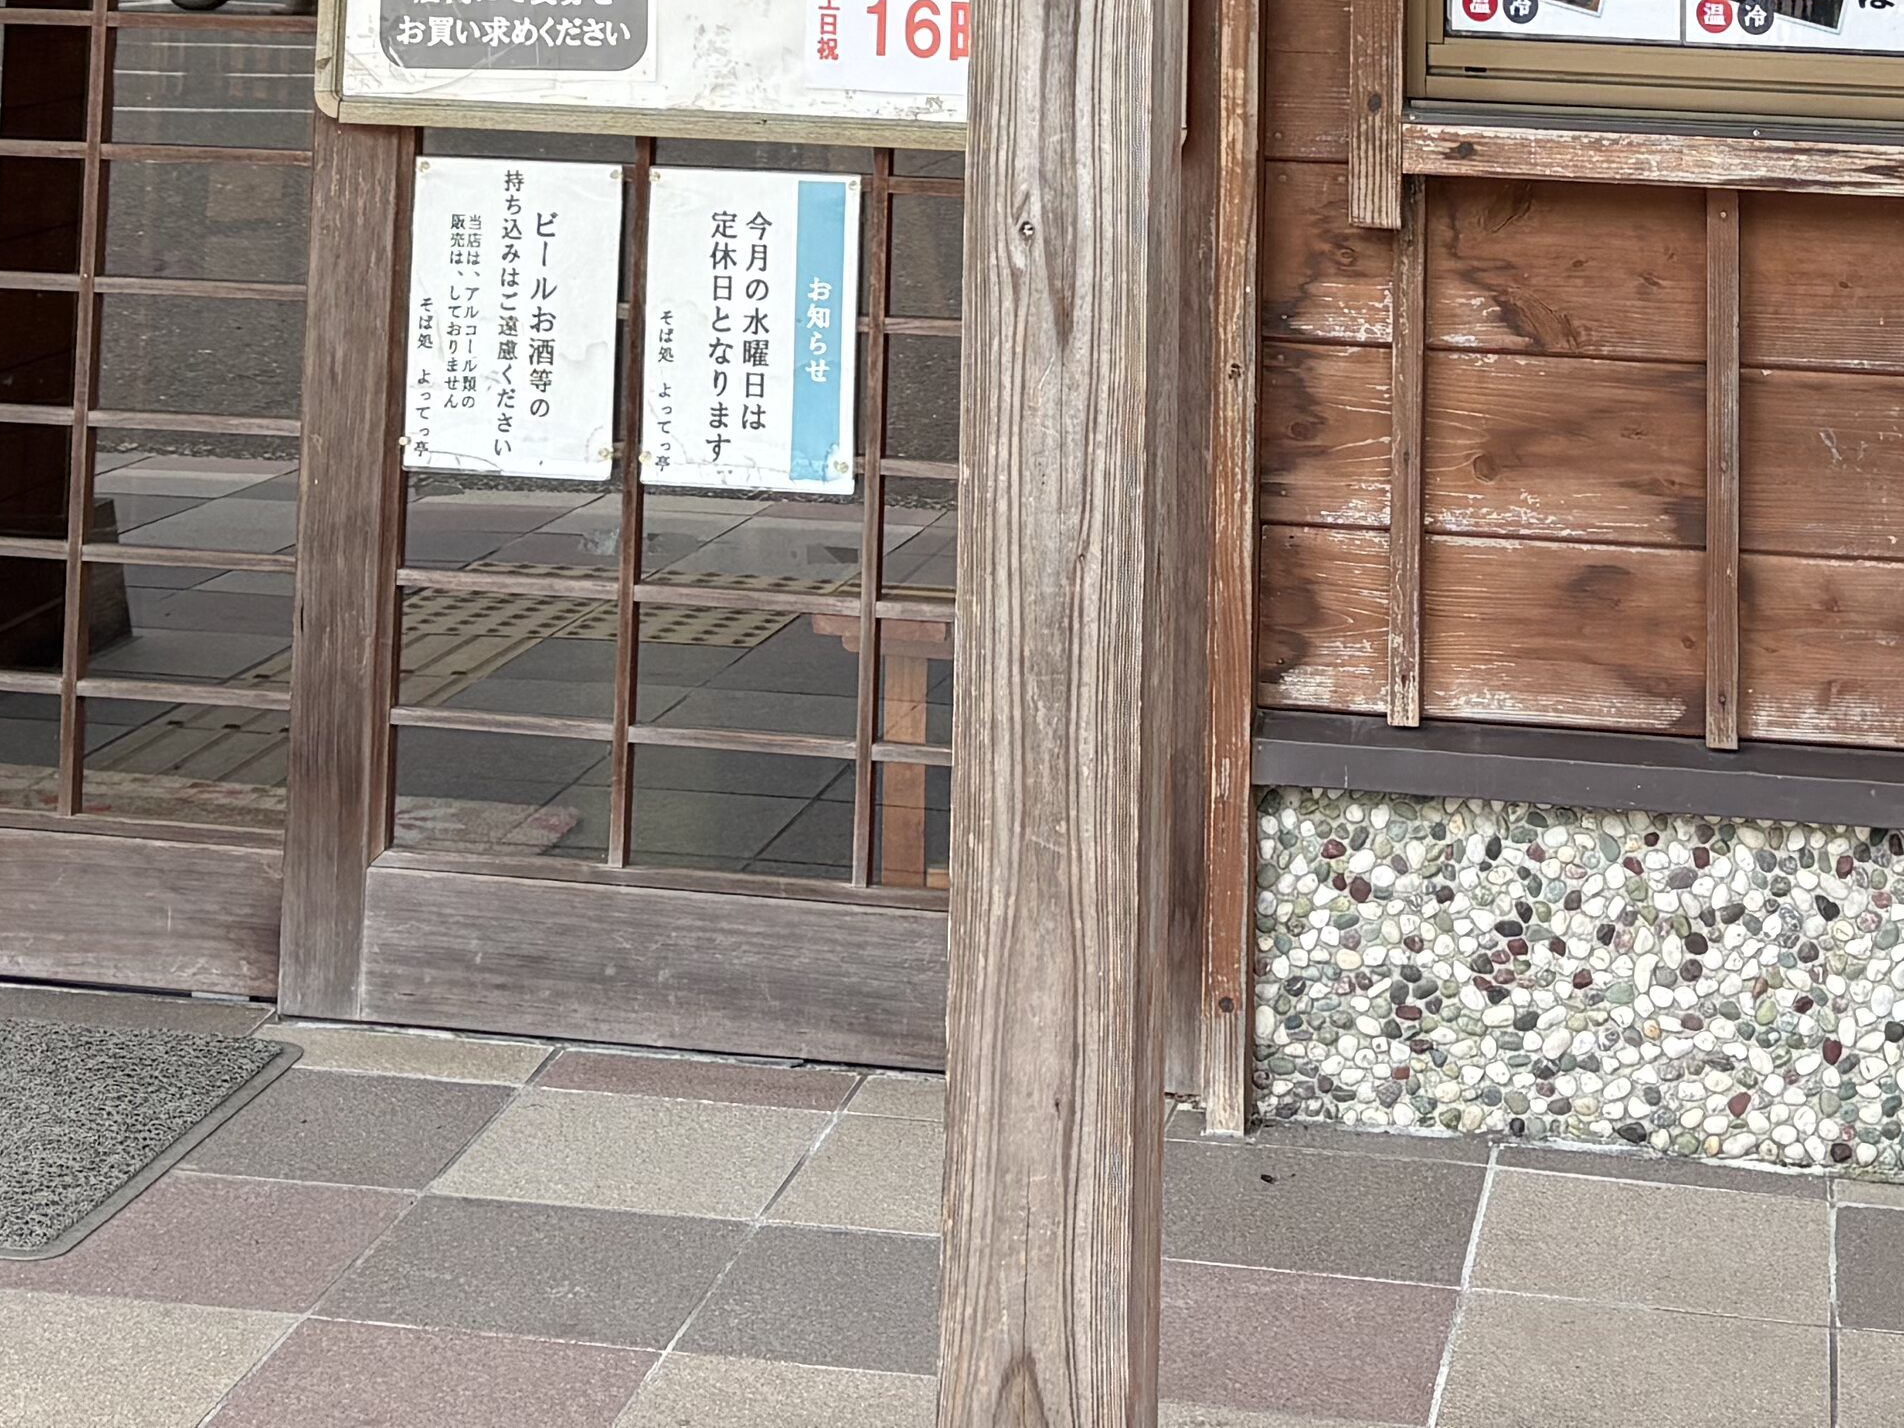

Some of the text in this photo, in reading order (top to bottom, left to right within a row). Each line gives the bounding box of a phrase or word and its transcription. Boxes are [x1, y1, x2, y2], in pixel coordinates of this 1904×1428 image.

[398, 17, 631, 47] お買い求めください
[418, 298, 433, 349] そば処
[495, 170, 525, 455] 持ち込みはご遠慮ください
[529, 212, 557, 419] ビールお酒等の
[658, 310, 675, 363] そば処
[706, 212, 738, 462] 定休日となります
[741, 212, 773, 430] 今月の水曜日は
[805, 278, 833, 382] お知らせ
